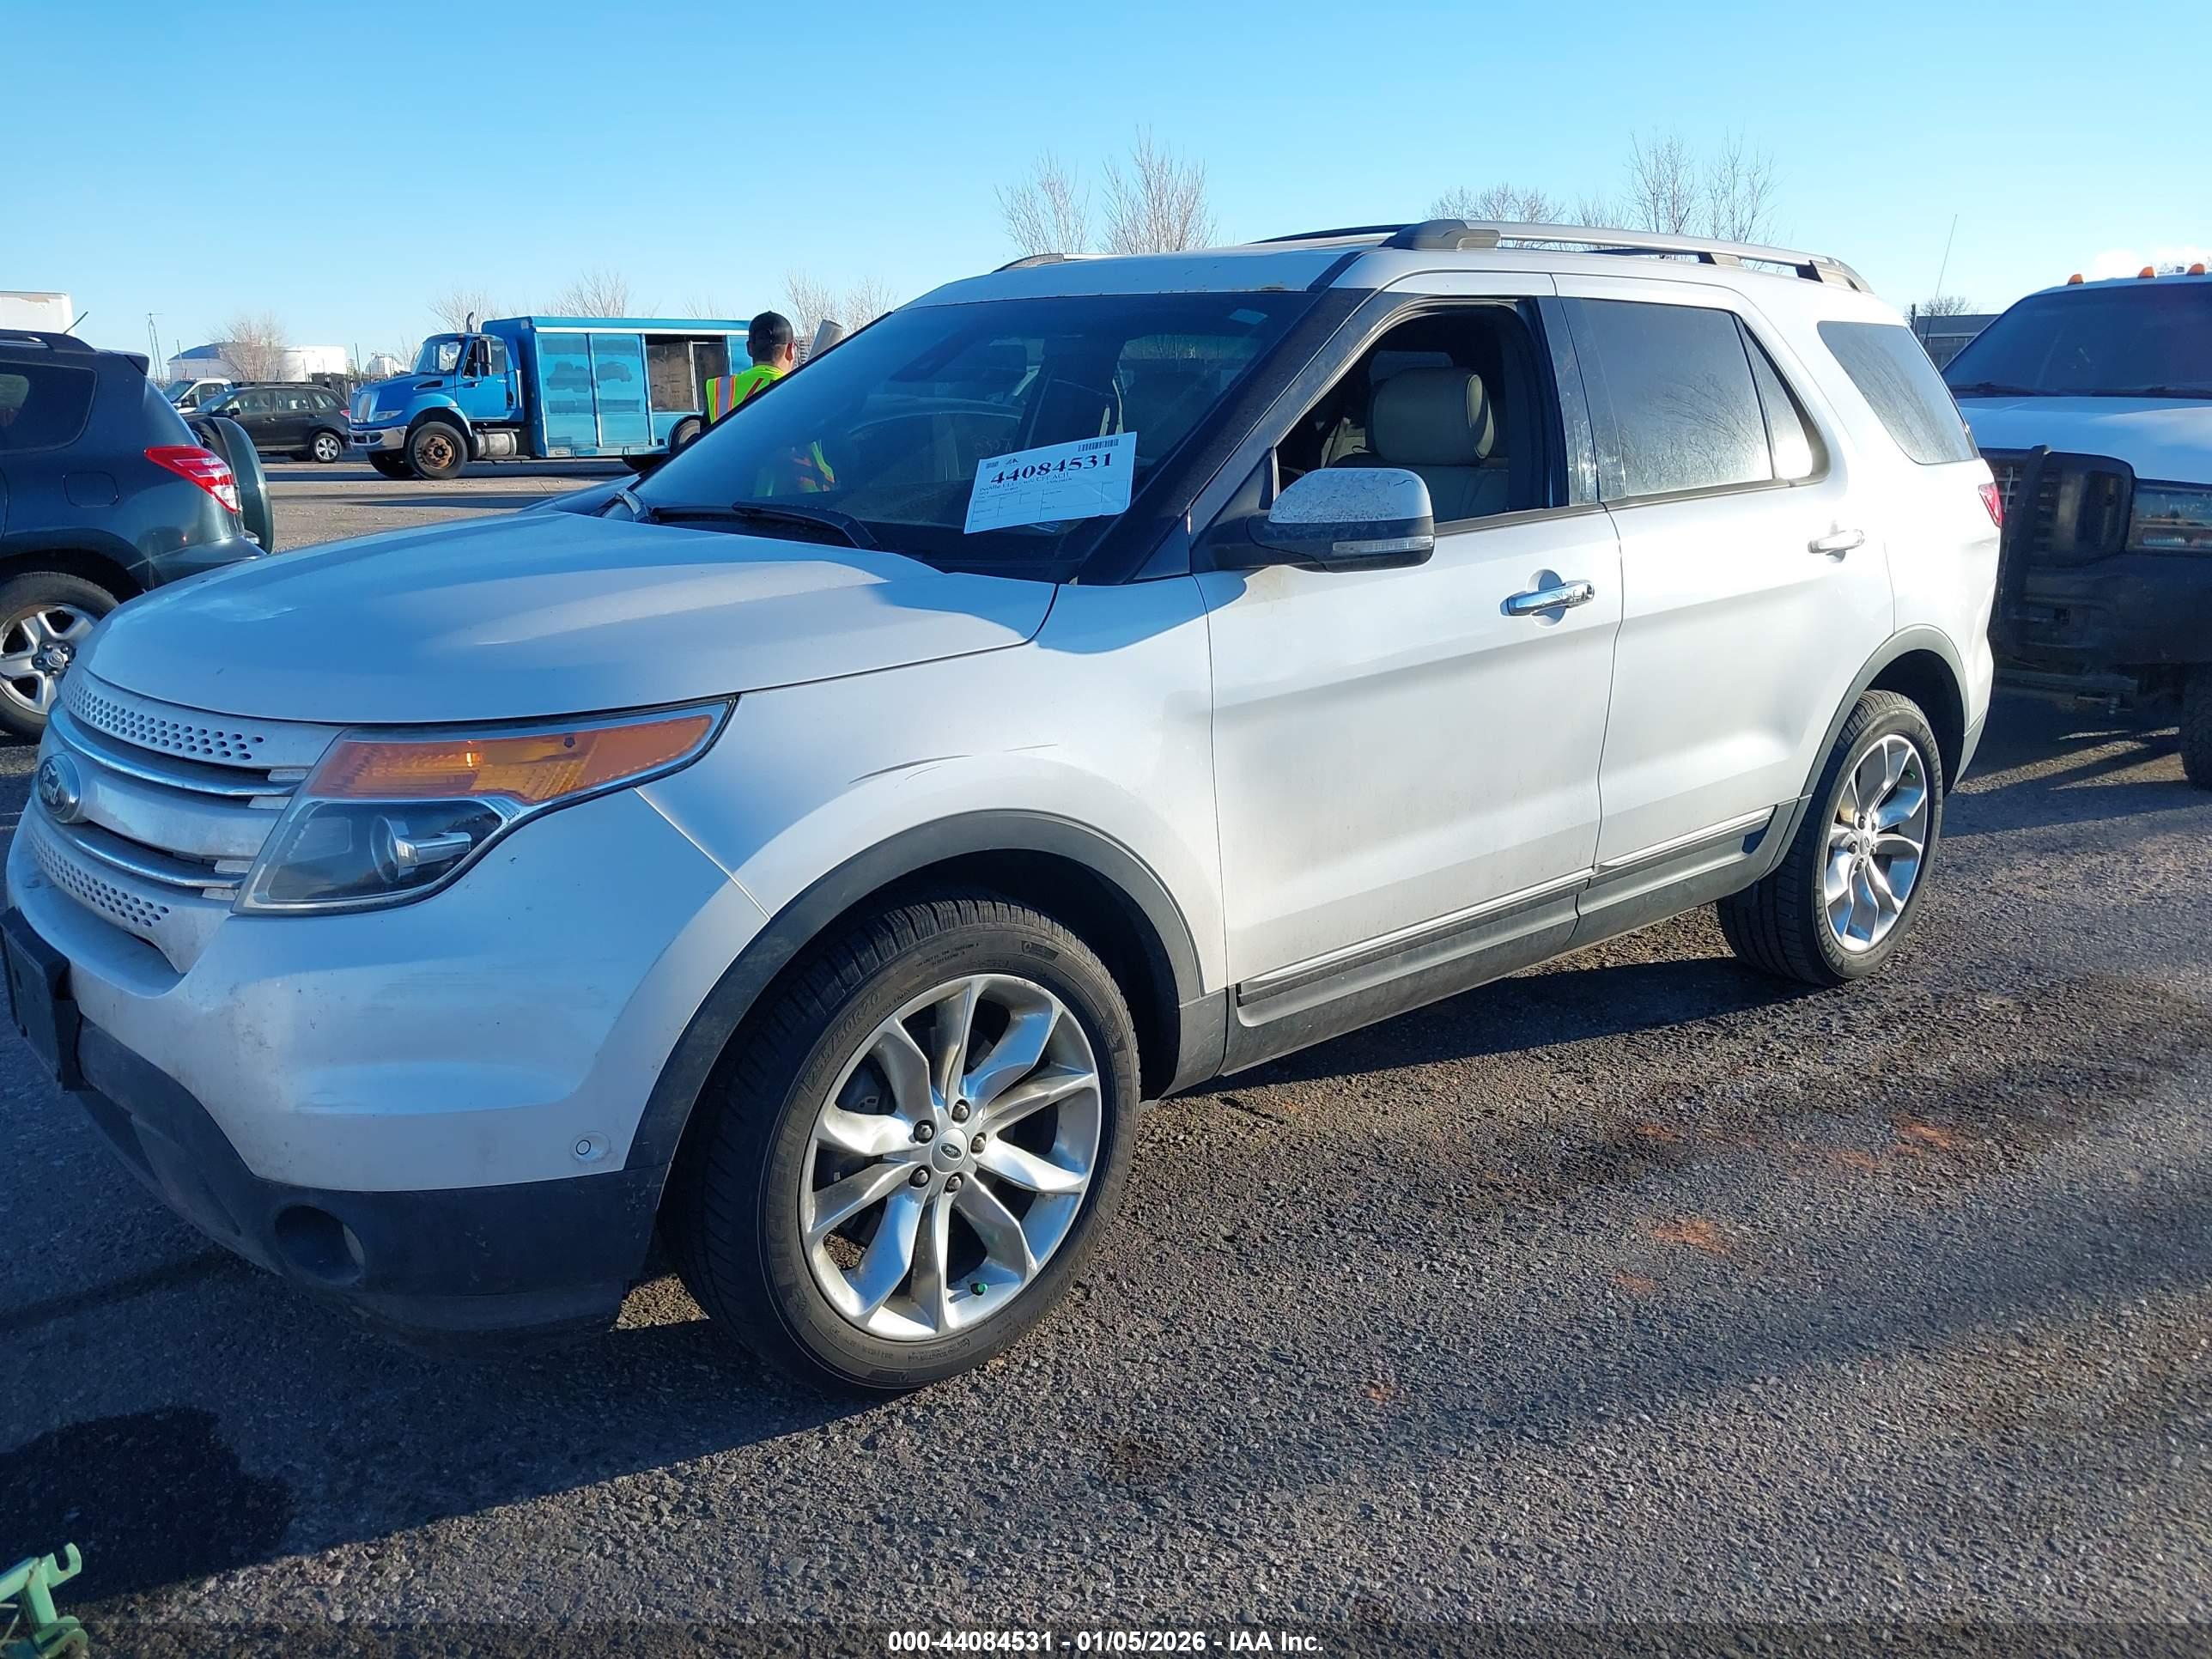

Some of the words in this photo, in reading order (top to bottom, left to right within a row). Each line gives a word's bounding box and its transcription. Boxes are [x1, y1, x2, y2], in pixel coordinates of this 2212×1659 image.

[991, 453, 1111, 484] 44084531
[40, 764, 61, 805] Ford
[808, 991, 881, 1085] 255/50R20
